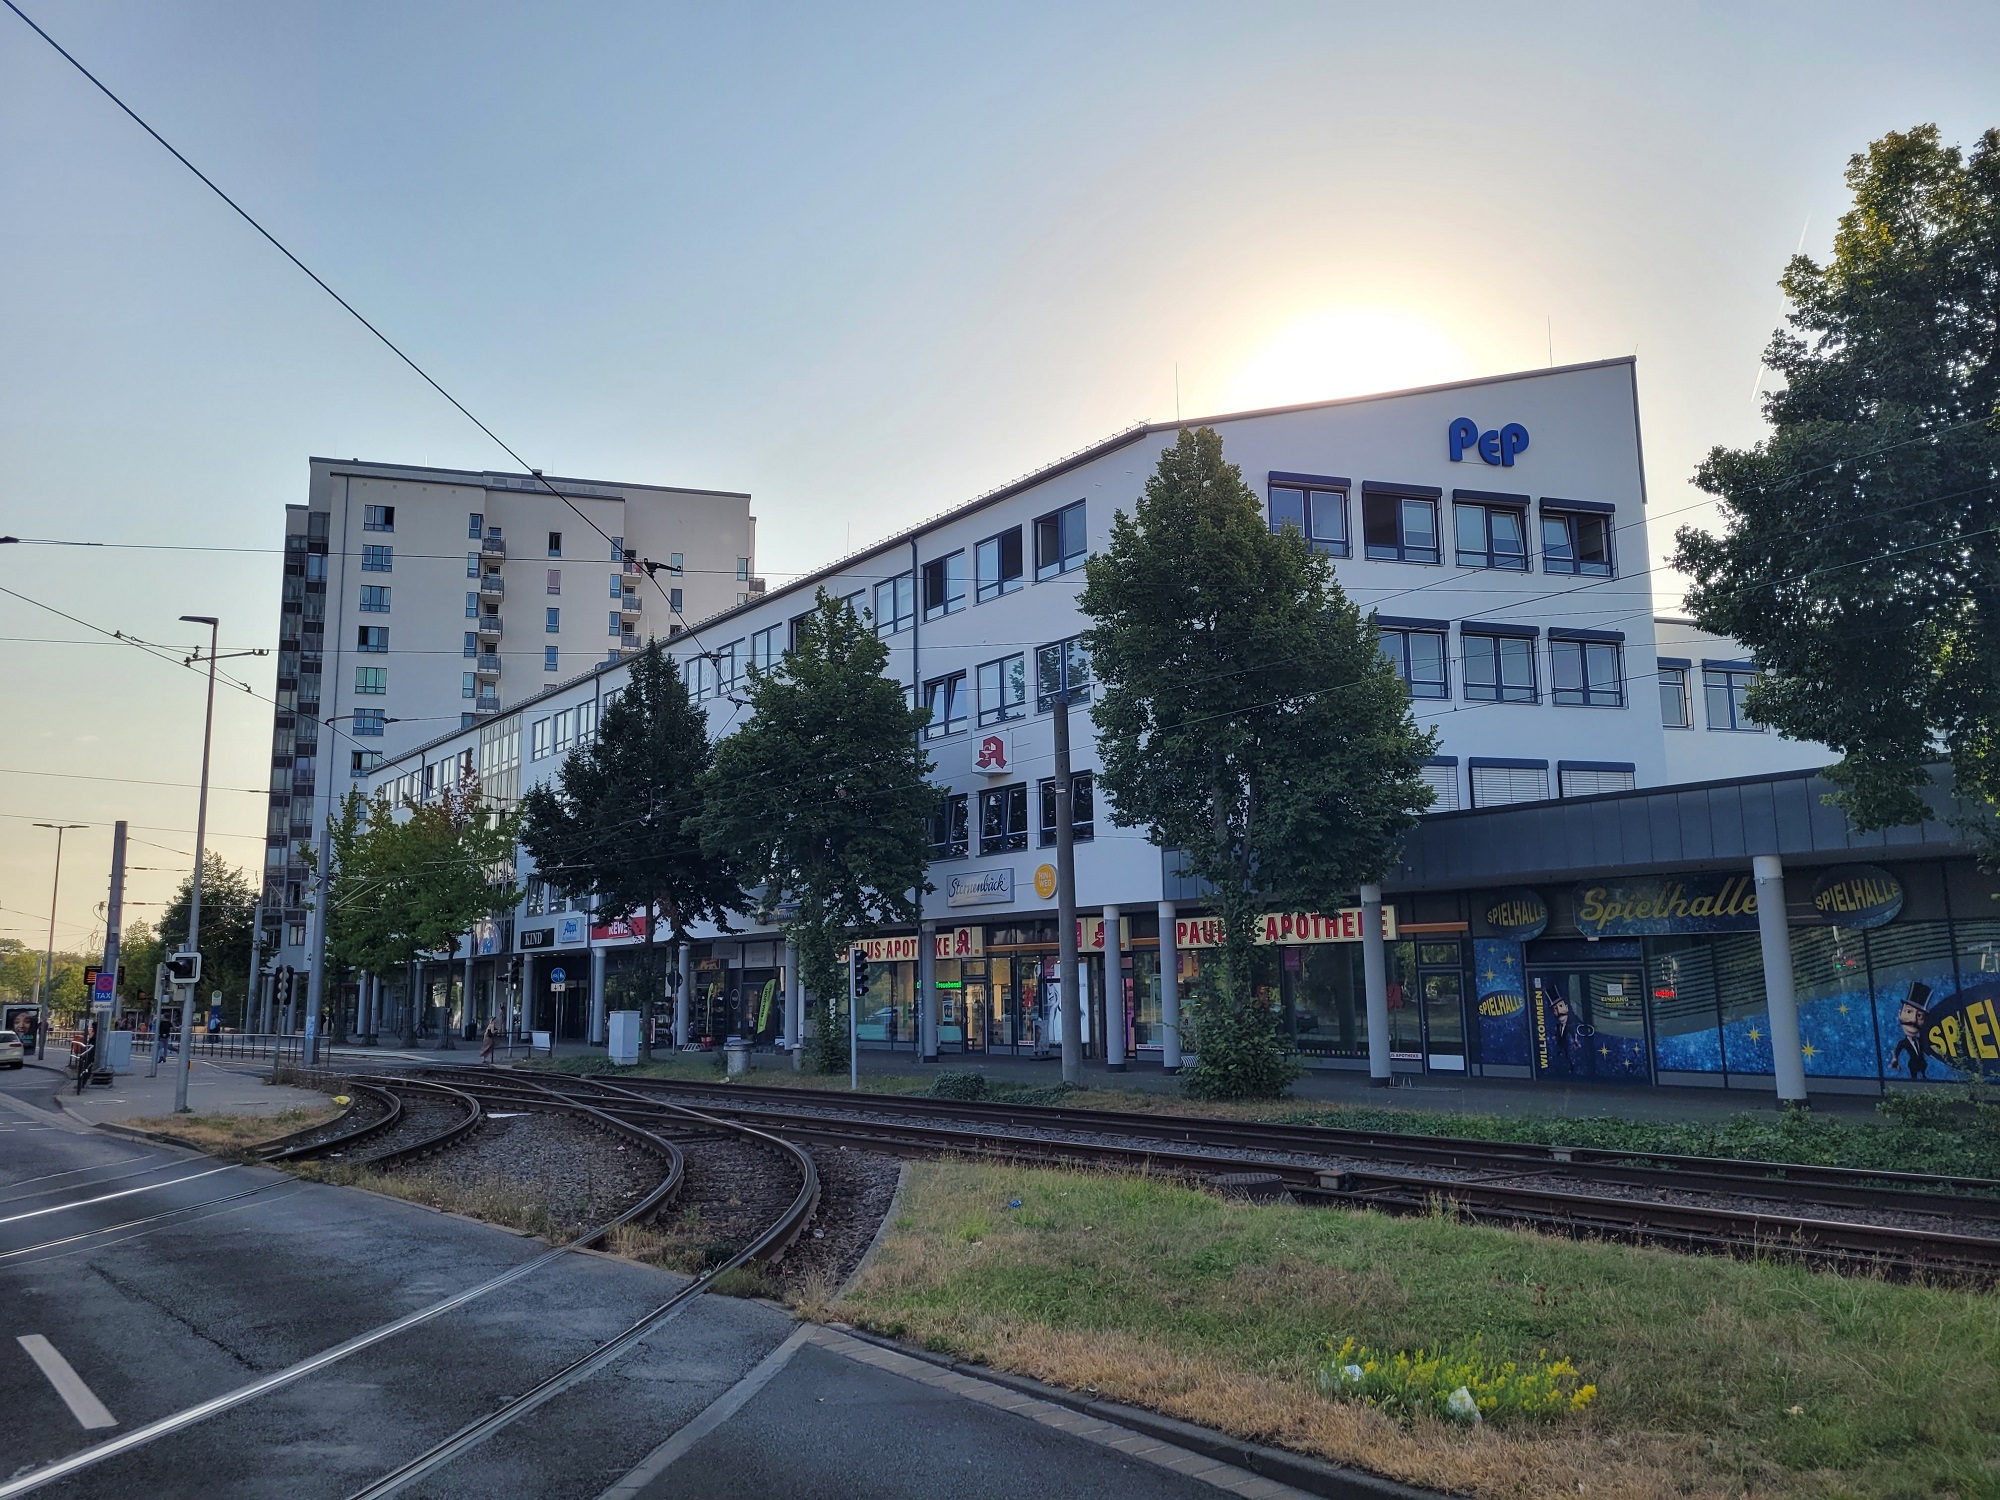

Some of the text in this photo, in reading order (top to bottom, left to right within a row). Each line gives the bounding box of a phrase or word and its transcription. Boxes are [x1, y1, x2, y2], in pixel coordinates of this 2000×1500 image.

[1039, 879, 1052, 887] WEG
[1815, 878, 1900, 912] SPIELHALLE
[1487, 900, 1548, 927] SPIELHALLE
[1579, 876, 1757, 930] Spielhalle
[524, 932, 543, 946] KIND
[1479, 994, 1524, 1016] SPIELHALLE
[1535, 990, 1549, 1069] WILLKOMMEN
